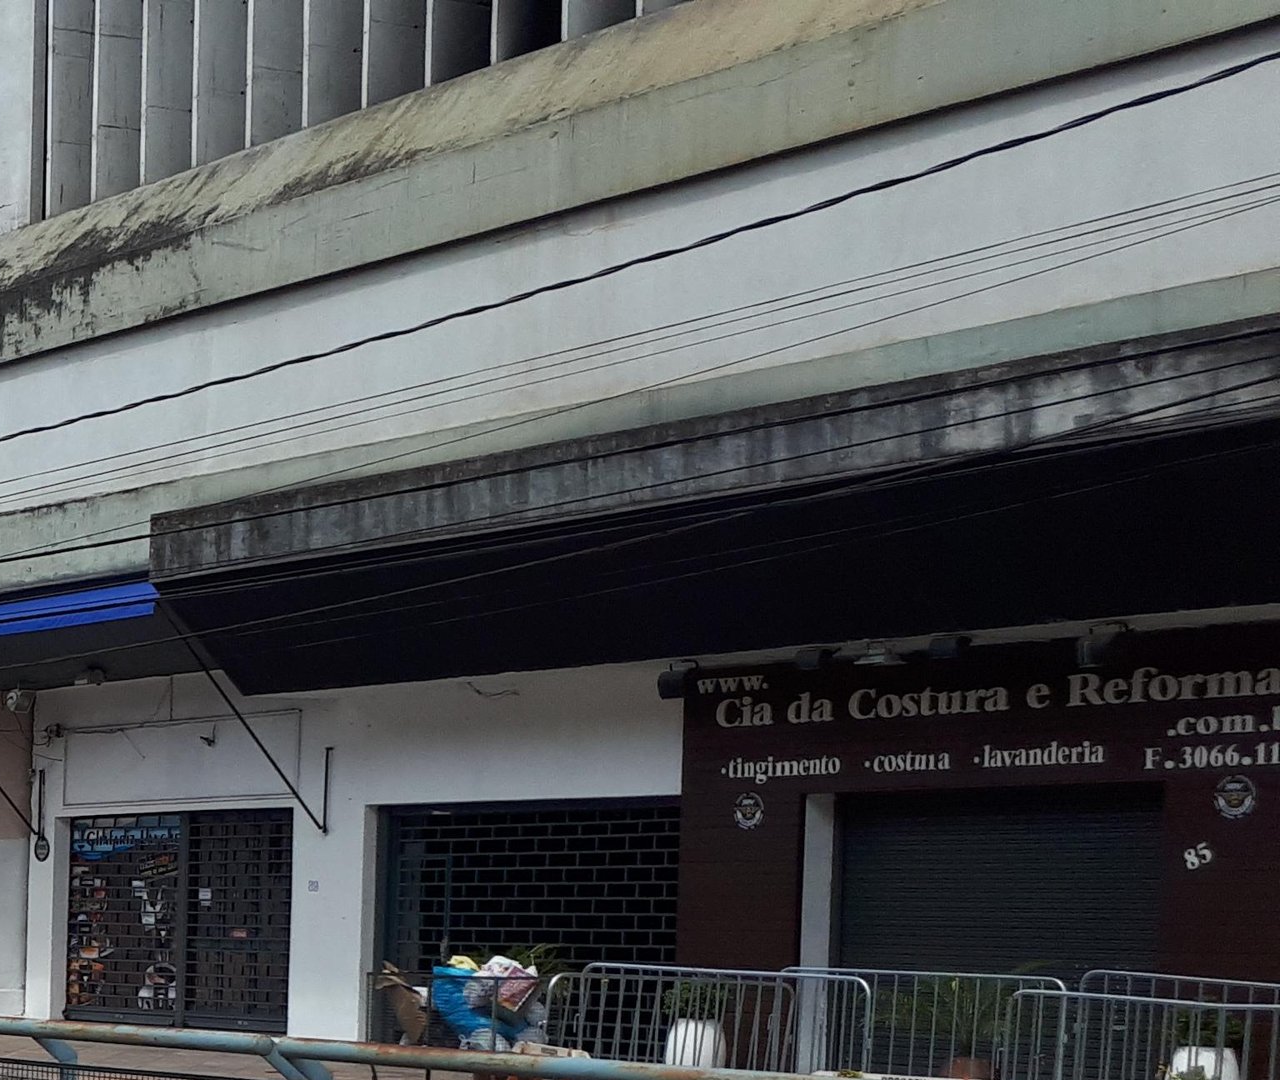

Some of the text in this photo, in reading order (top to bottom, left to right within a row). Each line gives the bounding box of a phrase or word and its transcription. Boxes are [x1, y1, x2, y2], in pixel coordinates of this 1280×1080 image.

[697, 675, 769, 694] www.
[715, 696, 774, 728] Cia
[787, 691, 834, 724] da
[848, 684, 1010, 719] Costura
[1026, 682, 1051, 708] e
[728, 755, 841, 784] tingimento
[982, 741, 1106, 770] lavanderia
[1184, 841, 1213, 871] 85
